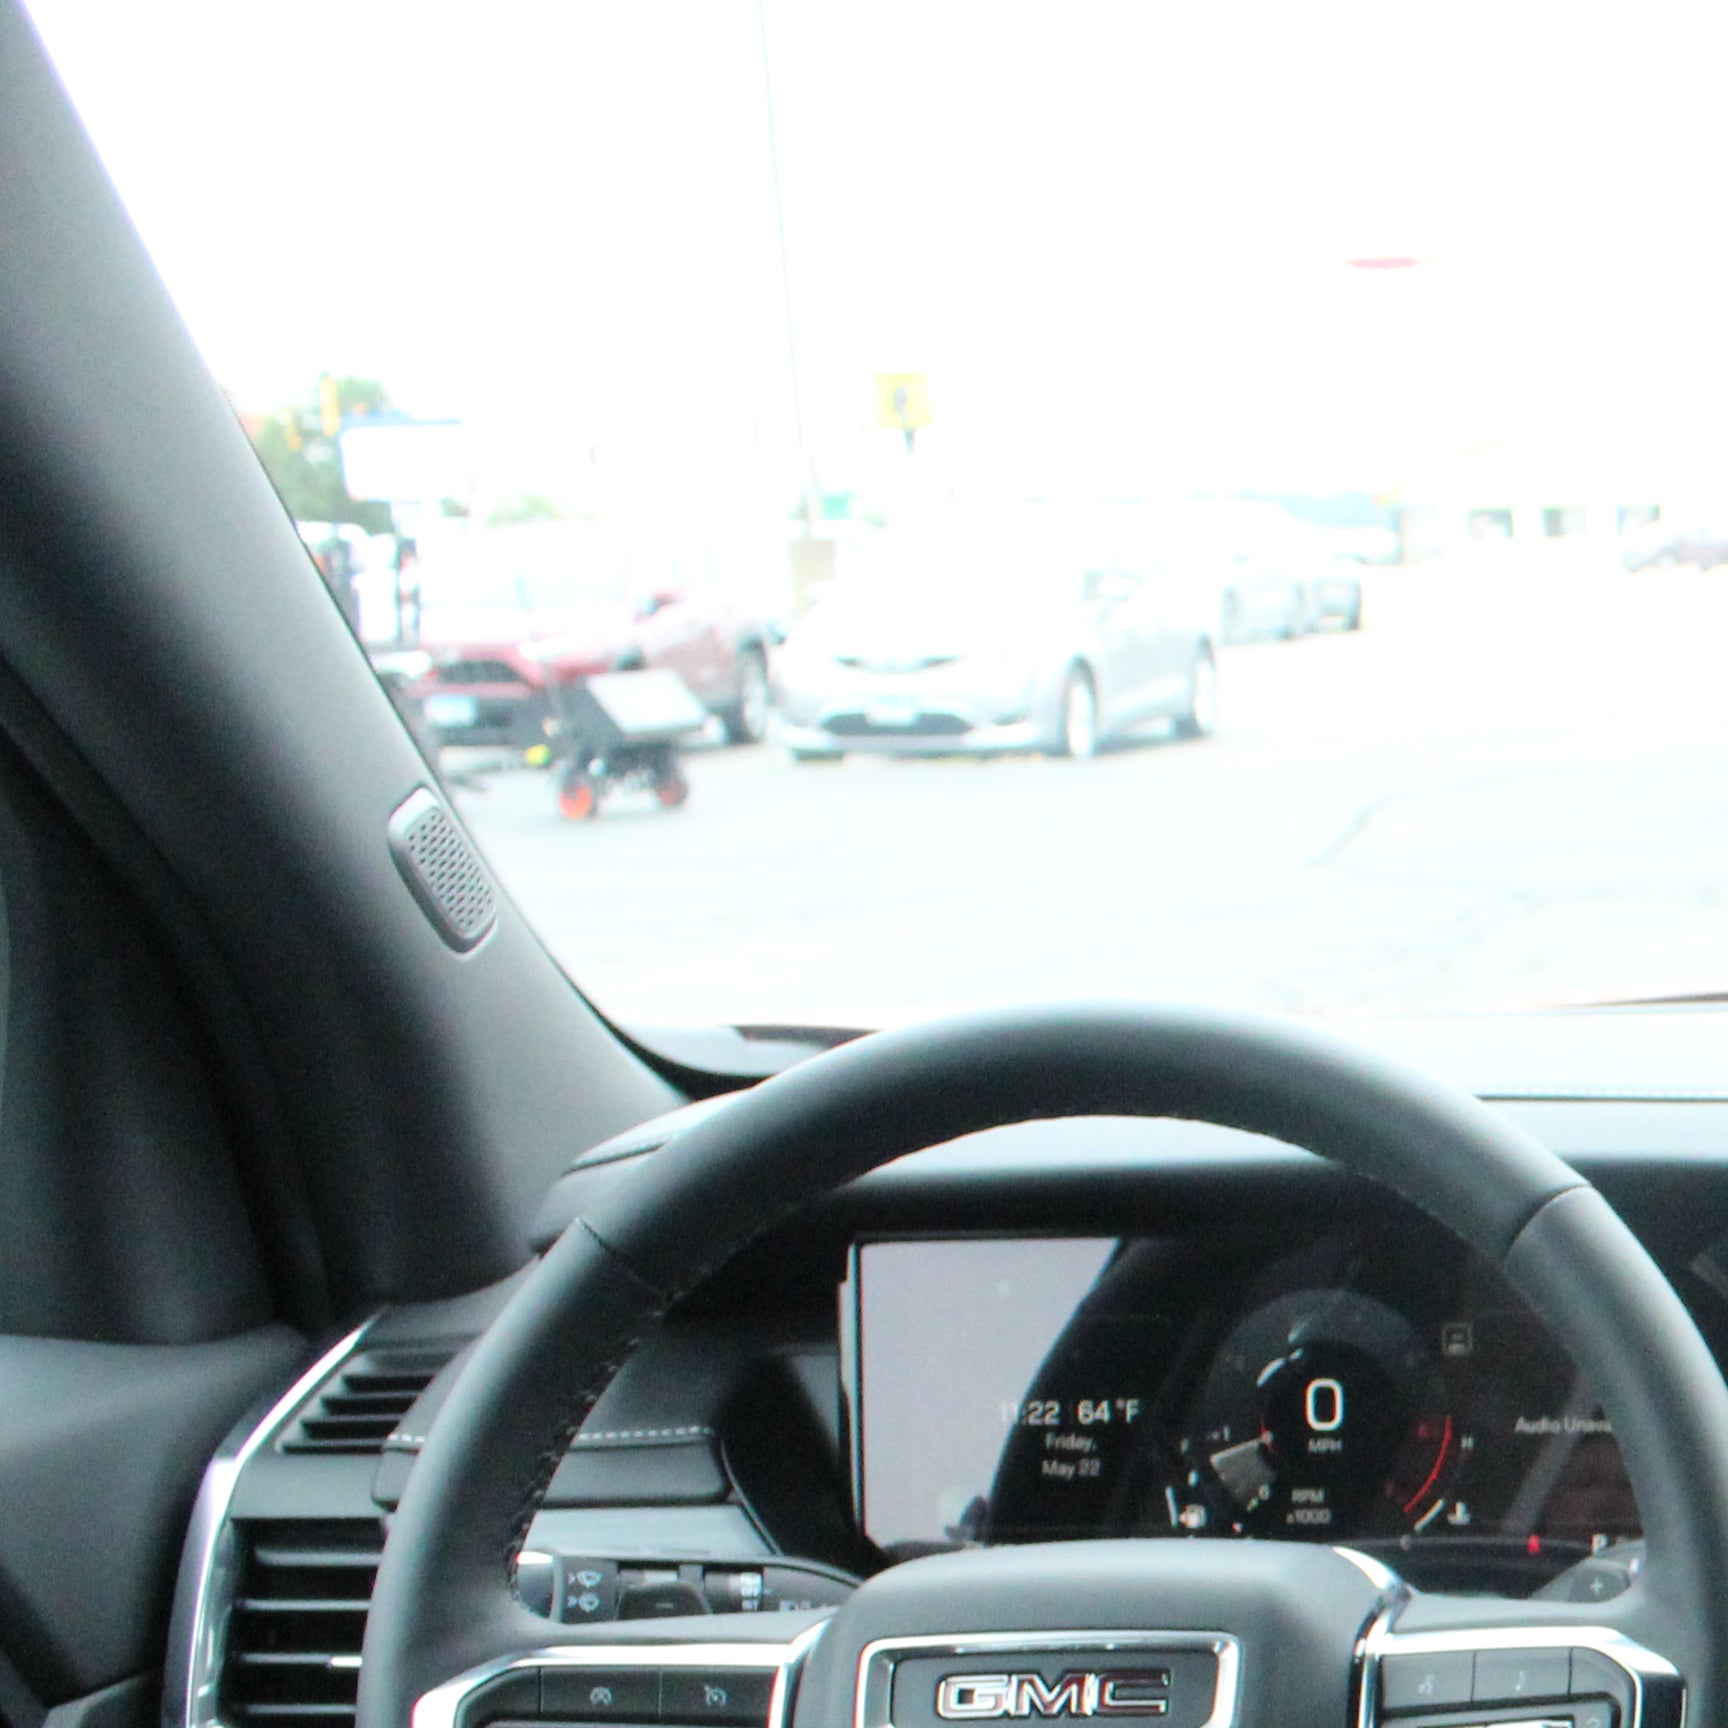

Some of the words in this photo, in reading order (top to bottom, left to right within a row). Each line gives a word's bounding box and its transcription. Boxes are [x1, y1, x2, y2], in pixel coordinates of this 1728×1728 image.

[1077, 1400, 1111, 1424] 64
[1305, 1378, 1344, 1431] 0
[1308, 1438, 1342, 1452] MPH
[1042, 1460, 1076, 1479] May
[936, 1668, 1173, 1721] GMC
